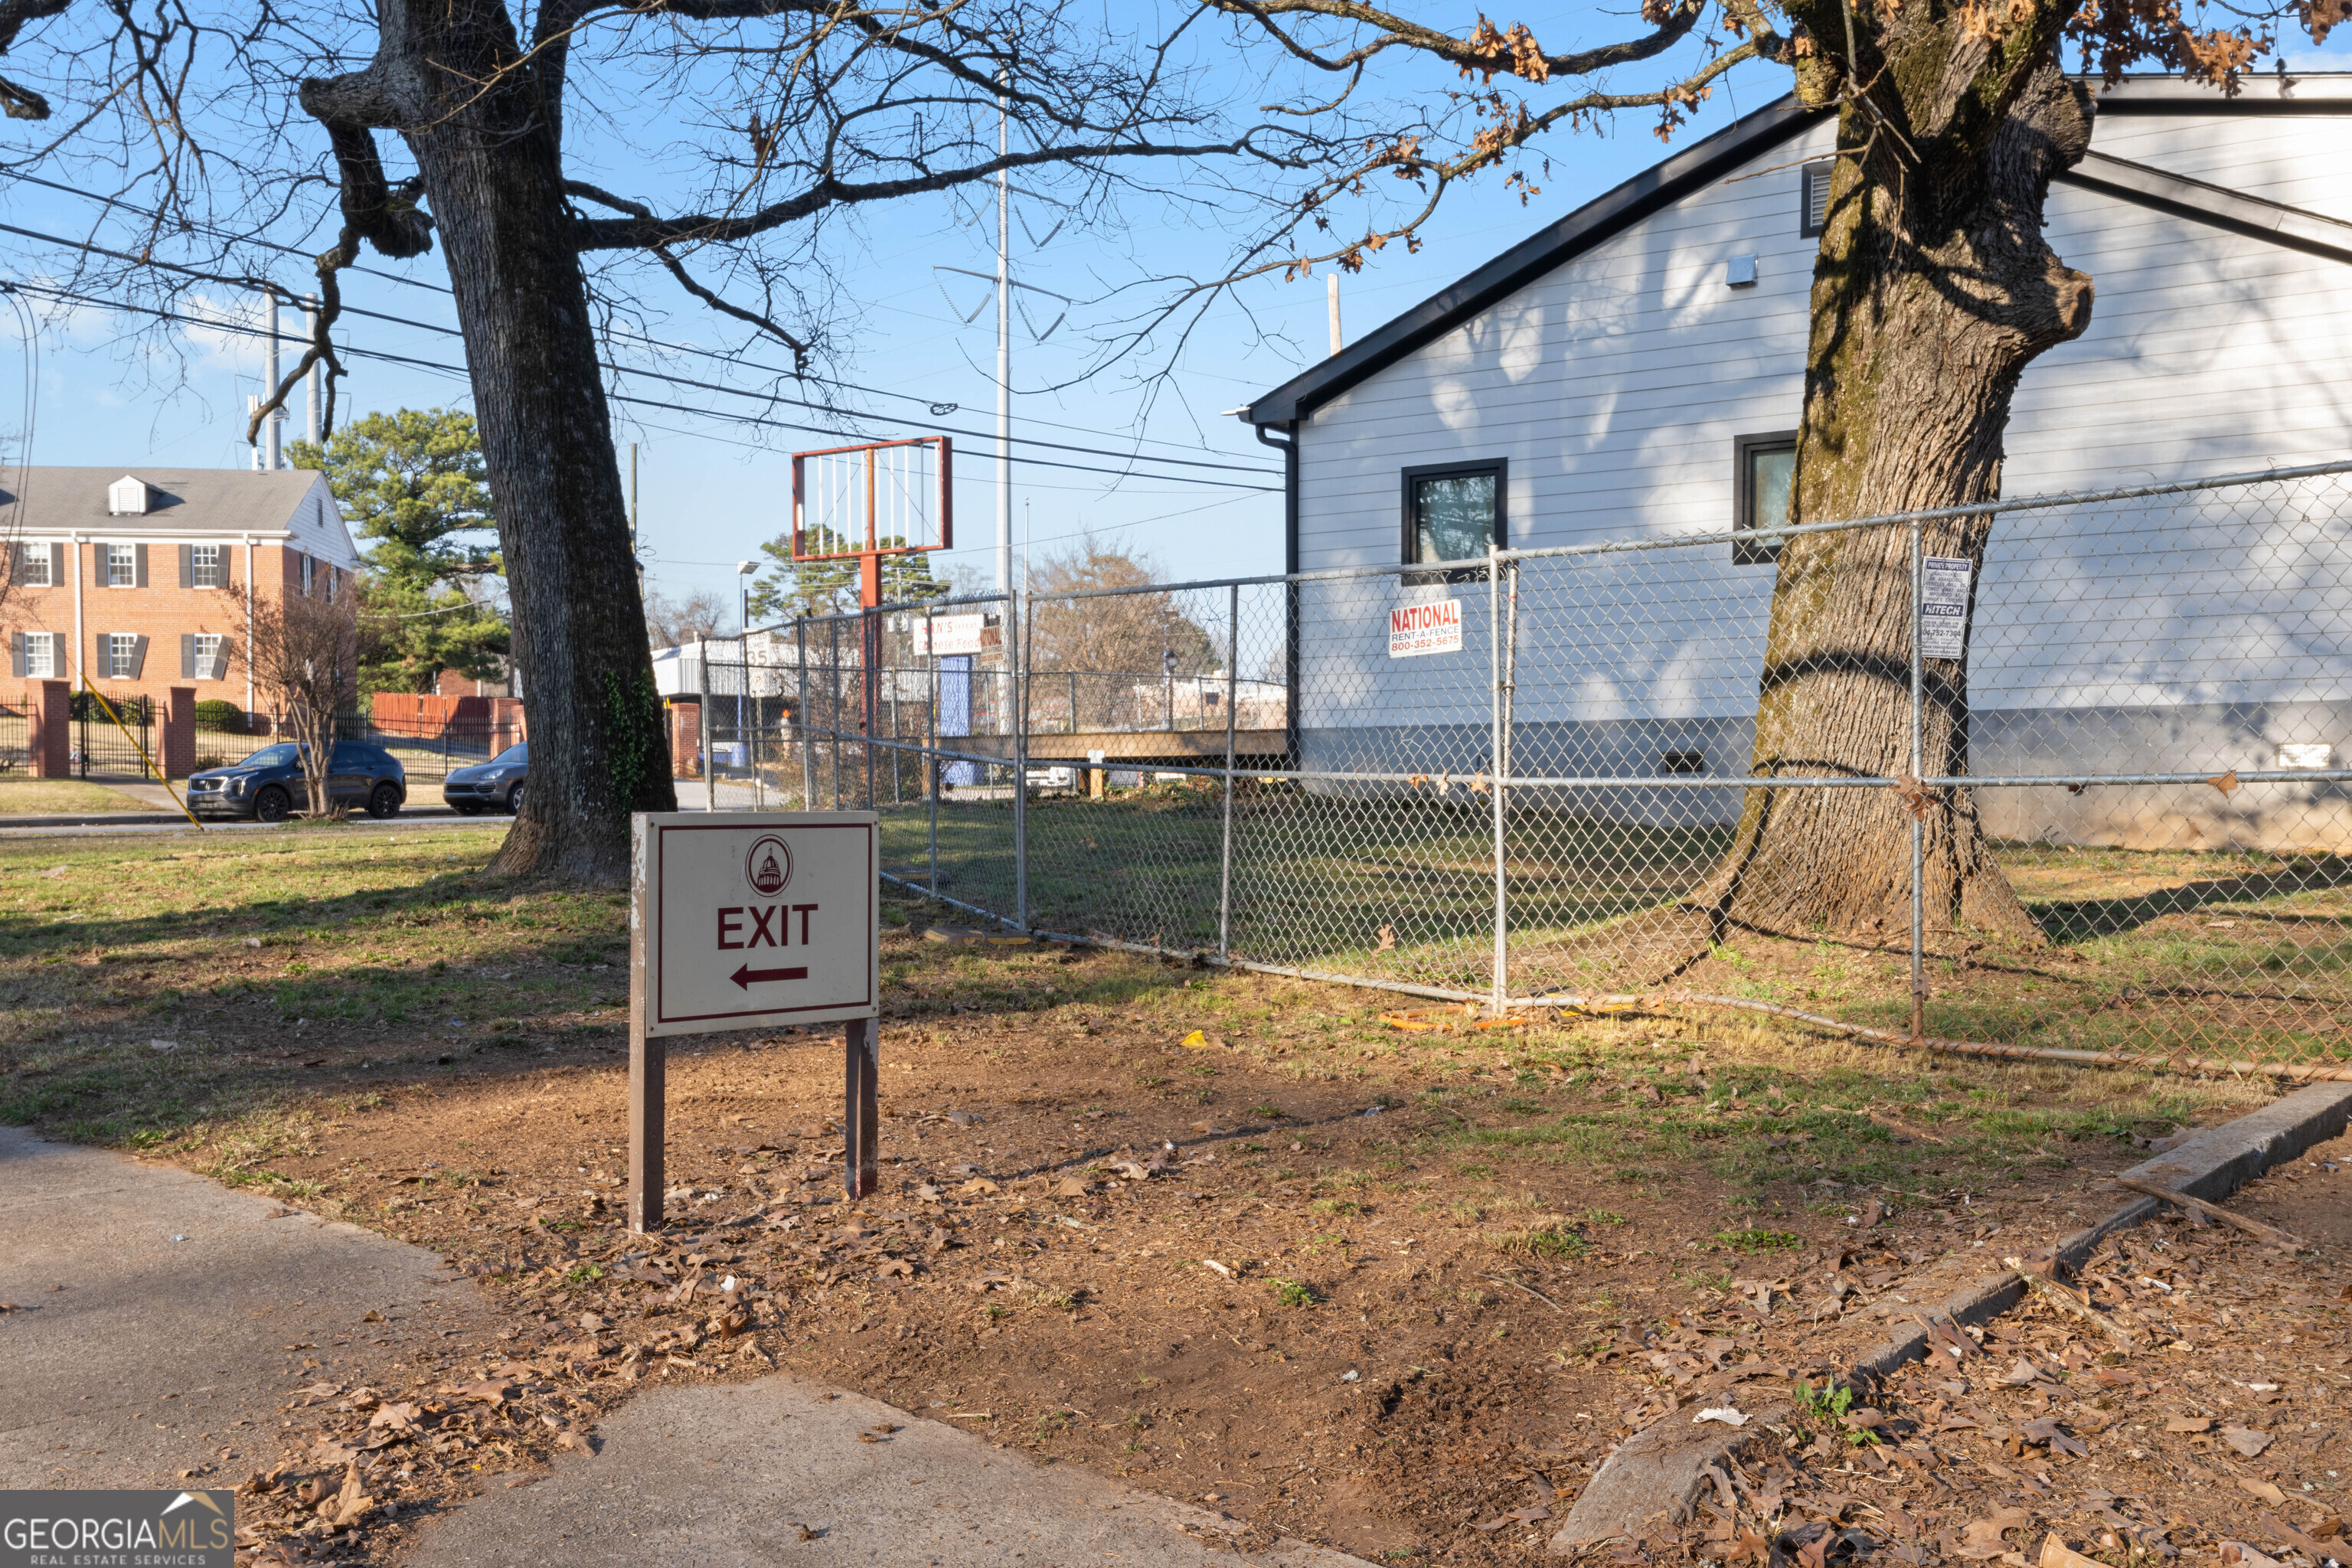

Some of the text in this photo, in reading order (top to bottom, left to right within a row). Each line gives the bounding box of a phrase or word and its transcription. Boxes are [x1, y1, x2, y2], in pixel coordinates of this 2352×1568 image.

[1392, 602, 1459, 633] NATIONAL
[1925, 604, 1962, 616] HITECH
[1392, 625, 1459, 642] RENT-A-FENCE
[1391, 635, 1459, 652] 800-352-5675
[746, 650, 767, 665] 35
[717, 903, 818, 950] EXIT
